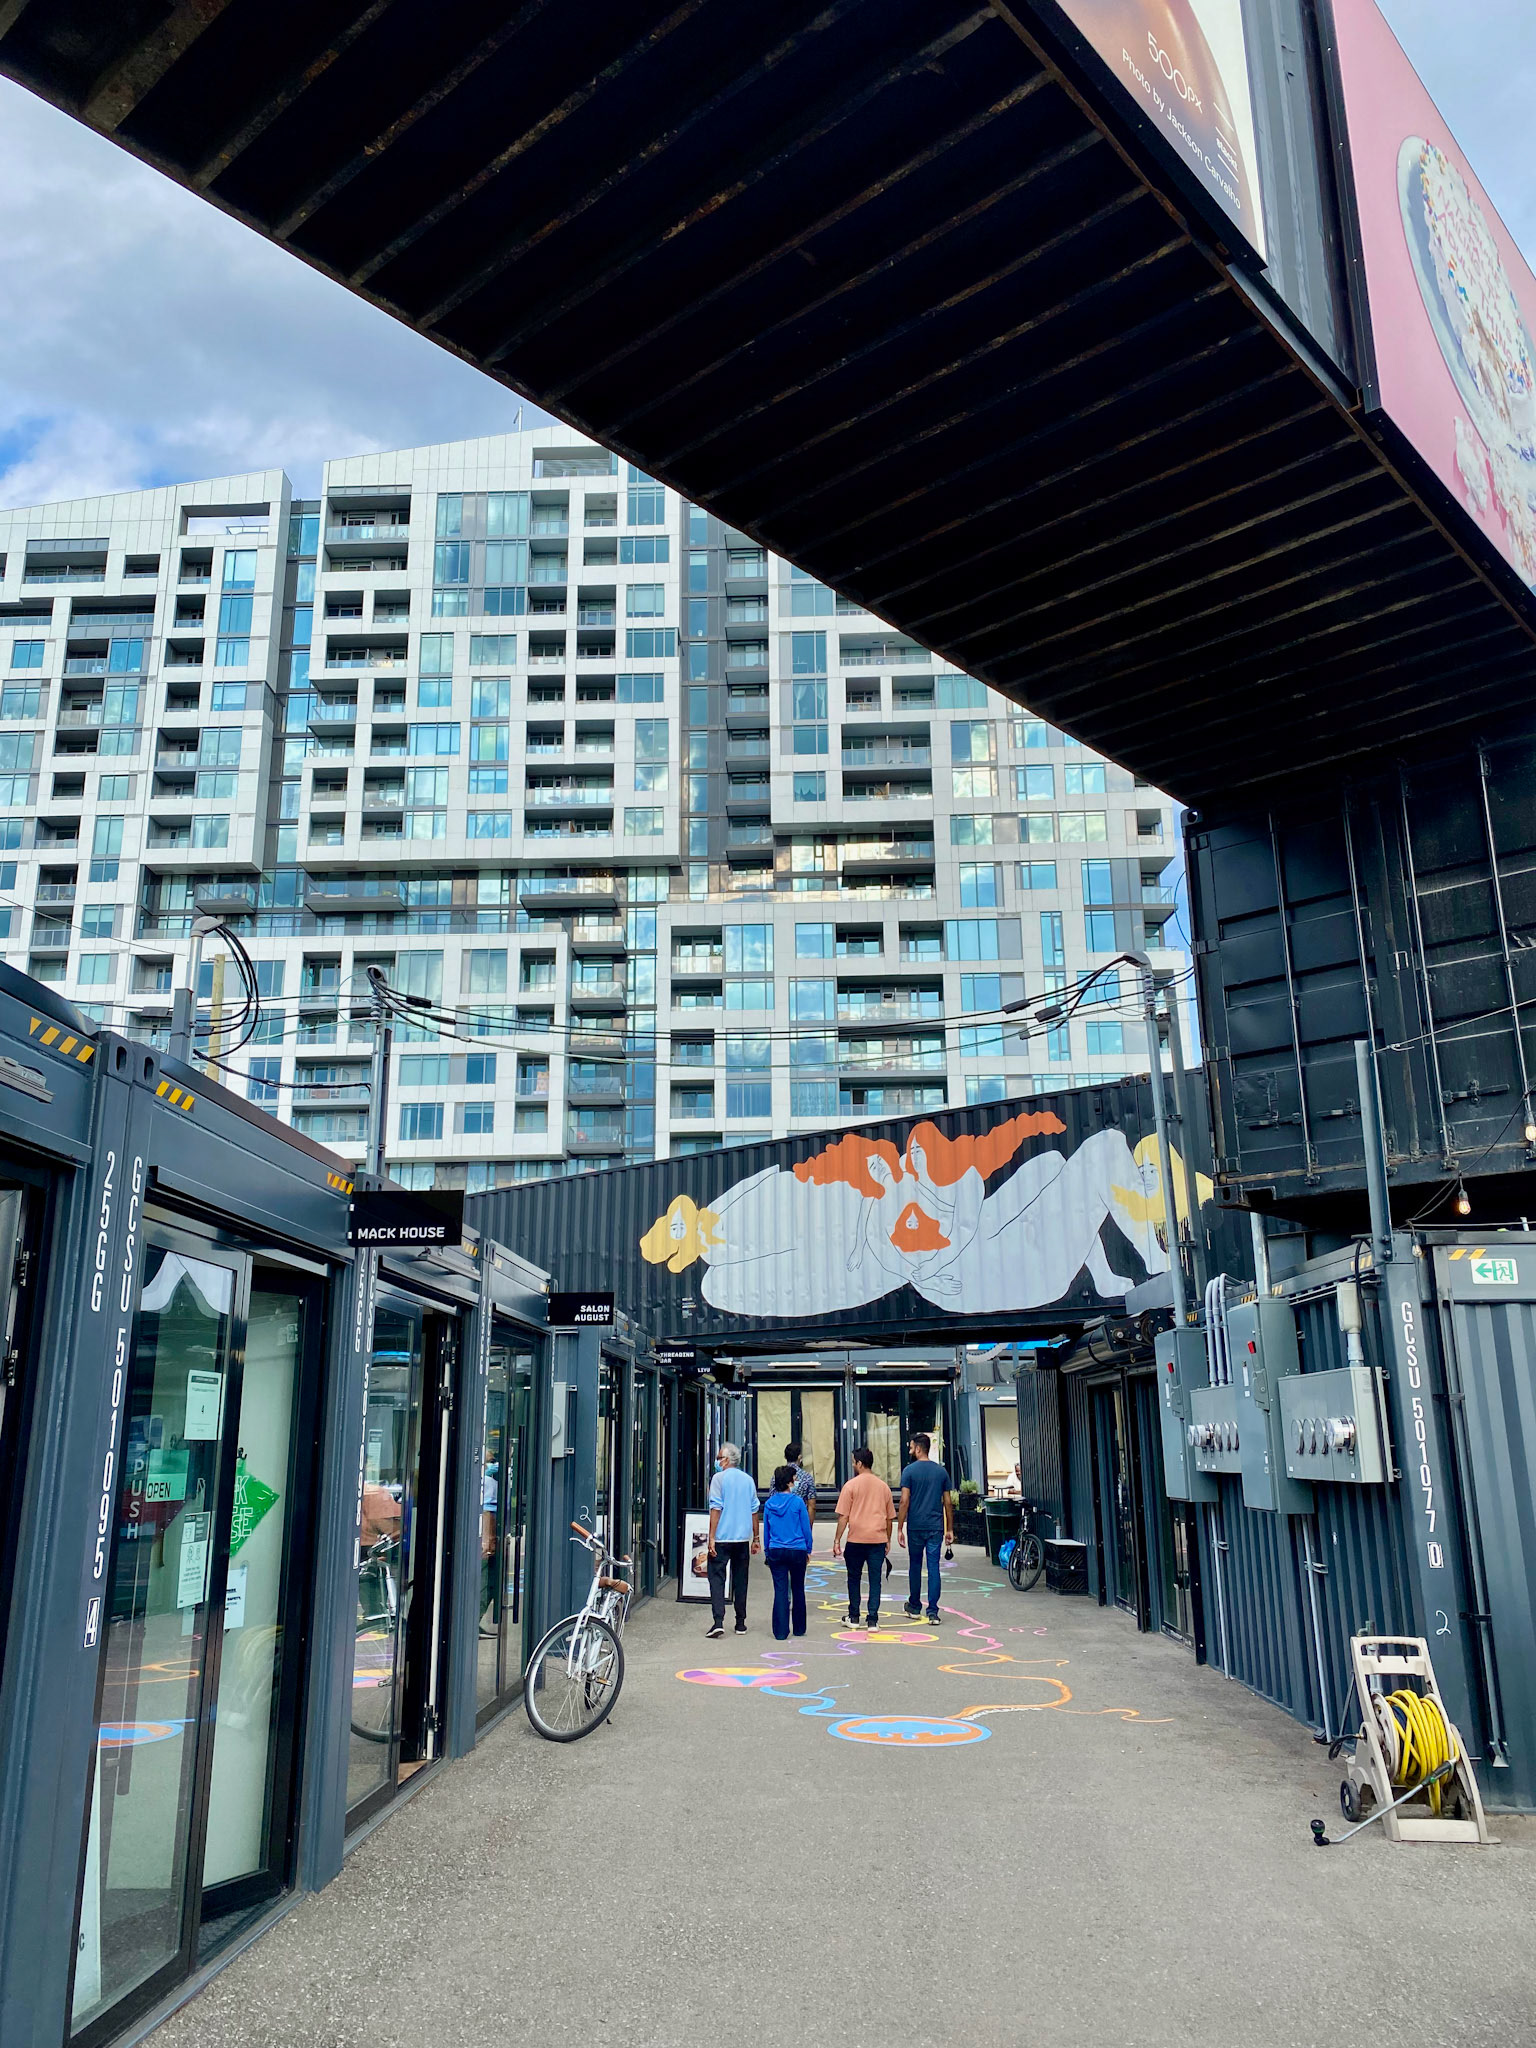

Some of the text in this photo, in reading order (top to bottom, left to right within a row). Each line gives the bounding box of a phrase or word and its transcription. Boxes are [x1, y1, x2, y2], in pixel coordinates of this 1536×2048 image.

[1148, 31, 1204, 113] 500px
[1122, 48, 1241, 209] Photo by Jackson Carvalho
[91, 1150, 116, 1312] 25GG
[357, 1226, 445, 1239] MACK HOUSE
[366, 1248, 377, 1353] GCSU
[84, 1156, 143, 1648] GCSU 501095 4
[1401, 1301, 1421, 1389] GCSU
[1411, 1397, 1436, 1533] 501077
[126, 1457, 145, 1540] PUSH
[146, 1482, 172, 1499] OPEN
[1435, 1609, 1452, 1636] 2
